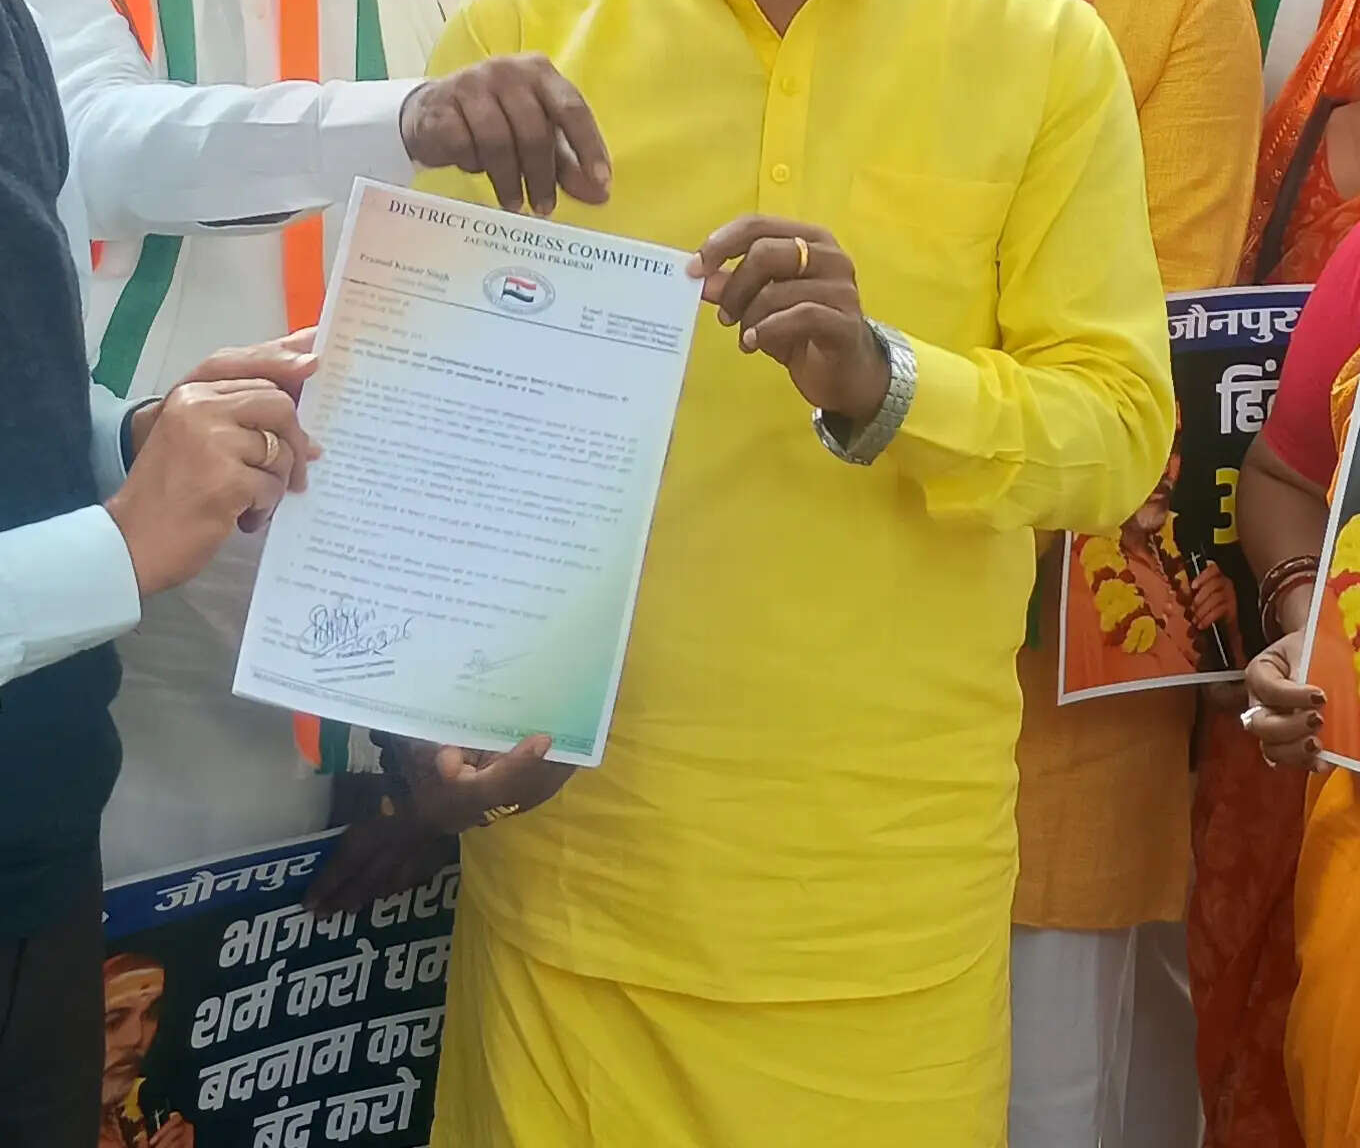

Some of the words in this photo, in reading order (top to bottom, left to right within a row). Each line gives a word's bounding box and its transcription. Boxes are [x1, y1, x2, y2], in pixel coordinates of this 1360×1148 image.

[389, 199, 469, 230] DISTRICT
[472, 218, 564, 252] CONGRESS
[567, 240, 674, 277] COMMITTEE
[1167, 304, 1304, 343] जौनपुर
[154, 852, 321, 912] जौनपुर
[191, 959, 287, 1049] शर्म
[286, 939, 379, 1018] करो
[197, 1022, 362, 1111] बदनाम
[367, 1005, 447, 1066] कर
[253, 1095, 320, 1148] बंद
[324, 1066, 421, 1142] करो
